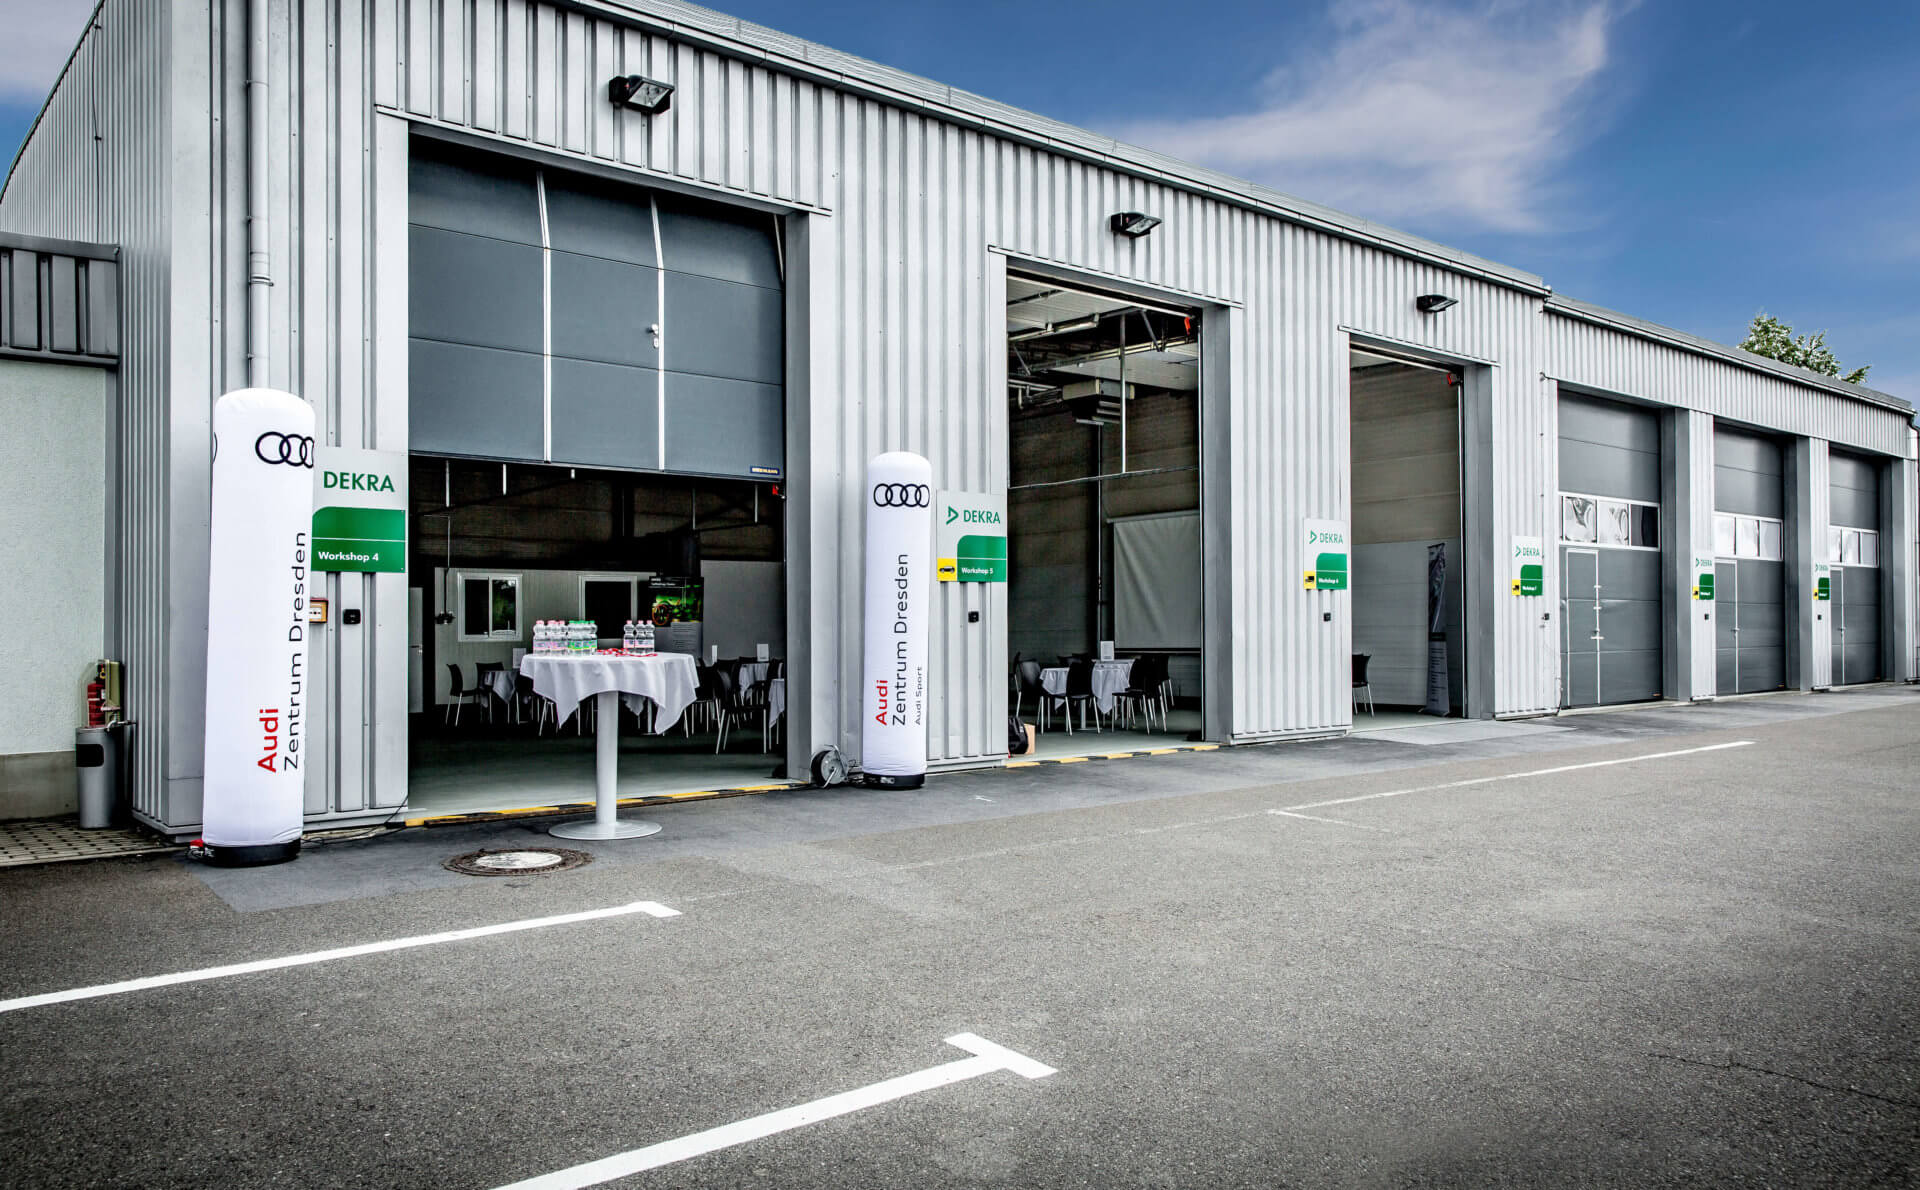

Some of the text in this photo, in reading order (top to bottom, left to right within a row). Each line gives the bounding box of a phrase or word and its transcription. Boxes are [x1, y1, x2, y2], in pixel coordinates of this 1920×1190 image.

[323, 471, 395, 492] DEKRA
[963, 509, 1001, 524] DEKRA
[1320, 532, 1344, 544] DEKRA
[318, 551, 379, 563] Workshop 4
[961, 567, 989, 575] Workshop
[284, 532, 306, 771] Zentrum Dresden
[892, 554, 909, 726] Zentrum Dresden
[876, 680, 889, 726] Audi
[914, 666, 923, 726] Audi Sport
[257, 708, 279, 773] Audi
